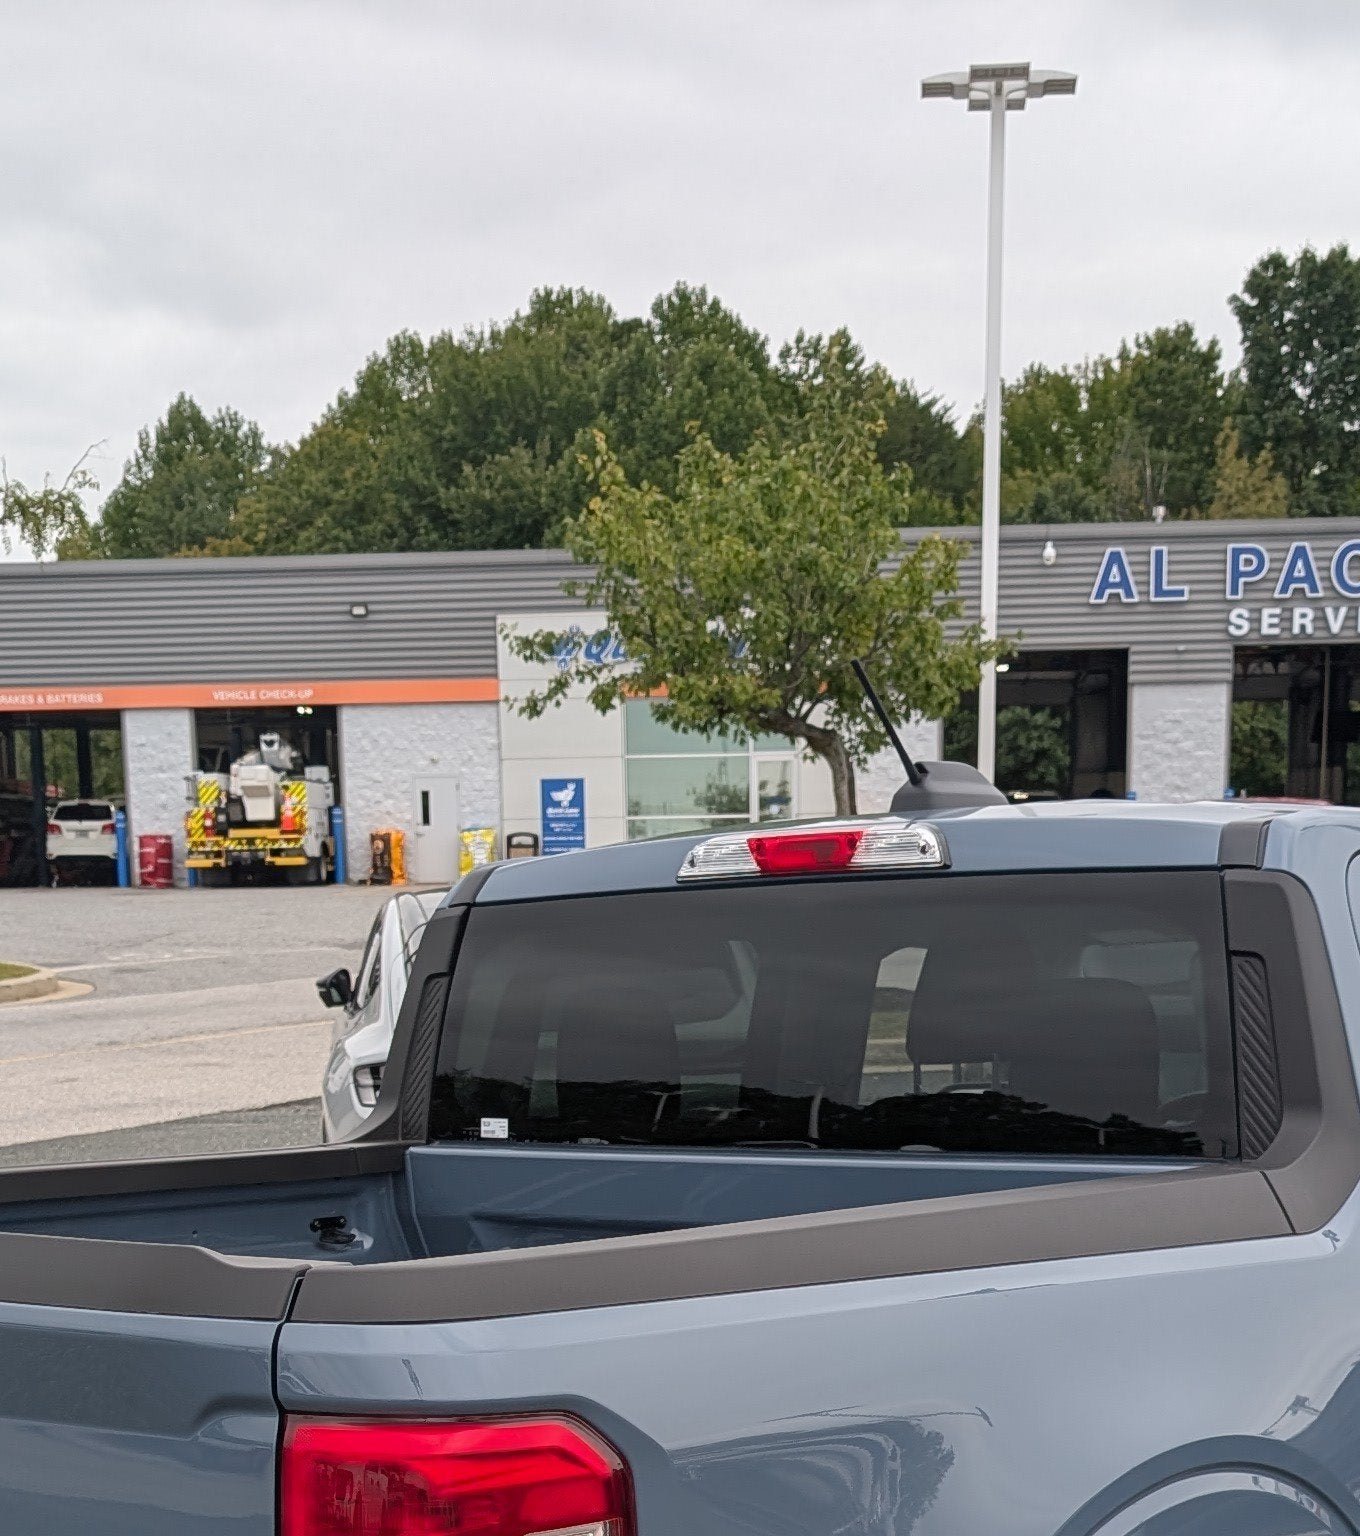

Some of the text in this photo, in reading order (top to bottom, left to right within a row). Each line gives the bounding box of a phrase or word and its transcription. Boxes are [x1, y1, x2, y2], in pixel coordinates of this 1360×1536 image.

[1089, 546, 1189, 605] AL
[46, 691, 104, 705] BATTERIES
[212, 689, 257, 701] VEHICLE
